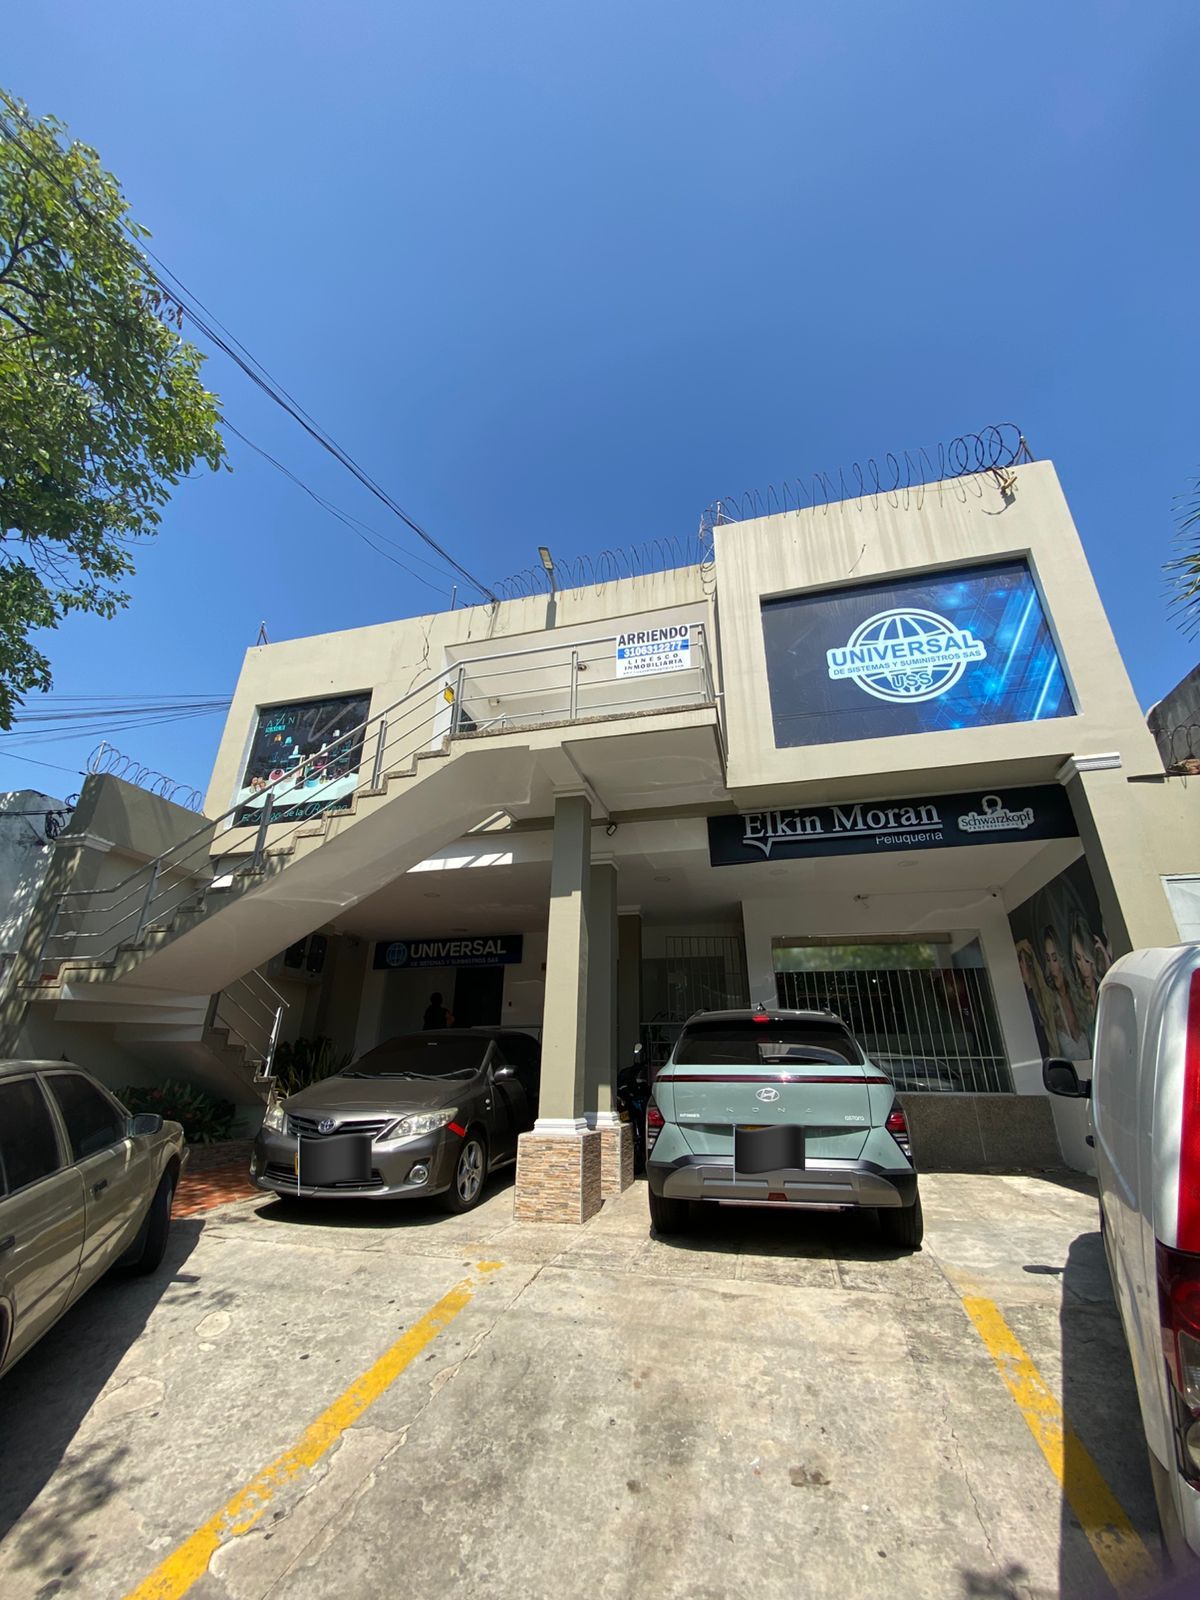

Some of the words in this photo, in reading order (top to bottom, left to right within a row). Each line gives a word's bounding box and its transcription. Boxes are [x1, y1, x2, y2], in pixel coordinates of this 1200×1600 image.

[618, 626, 688, 646] ARRIENDO
[623, 640, 682, 658] 3106312277
[831, 633, 979, 666] UNIVERSAL
[625, 659, 682, 670] INMOBILIARIA
[628, 653, 679, 665] LINESCO
[847, 663, 891, 674] SISTEMAS
[900, 653, 961, 667] SUMINISTROS
[963, 649, 982, 658] SAS
[890, 673, 932, 689] USS
[743, 809, 825, 839] Elkin
[832, 804, 943, 831] Moran
[410, 939, 507, 958] UNIVERSAL
